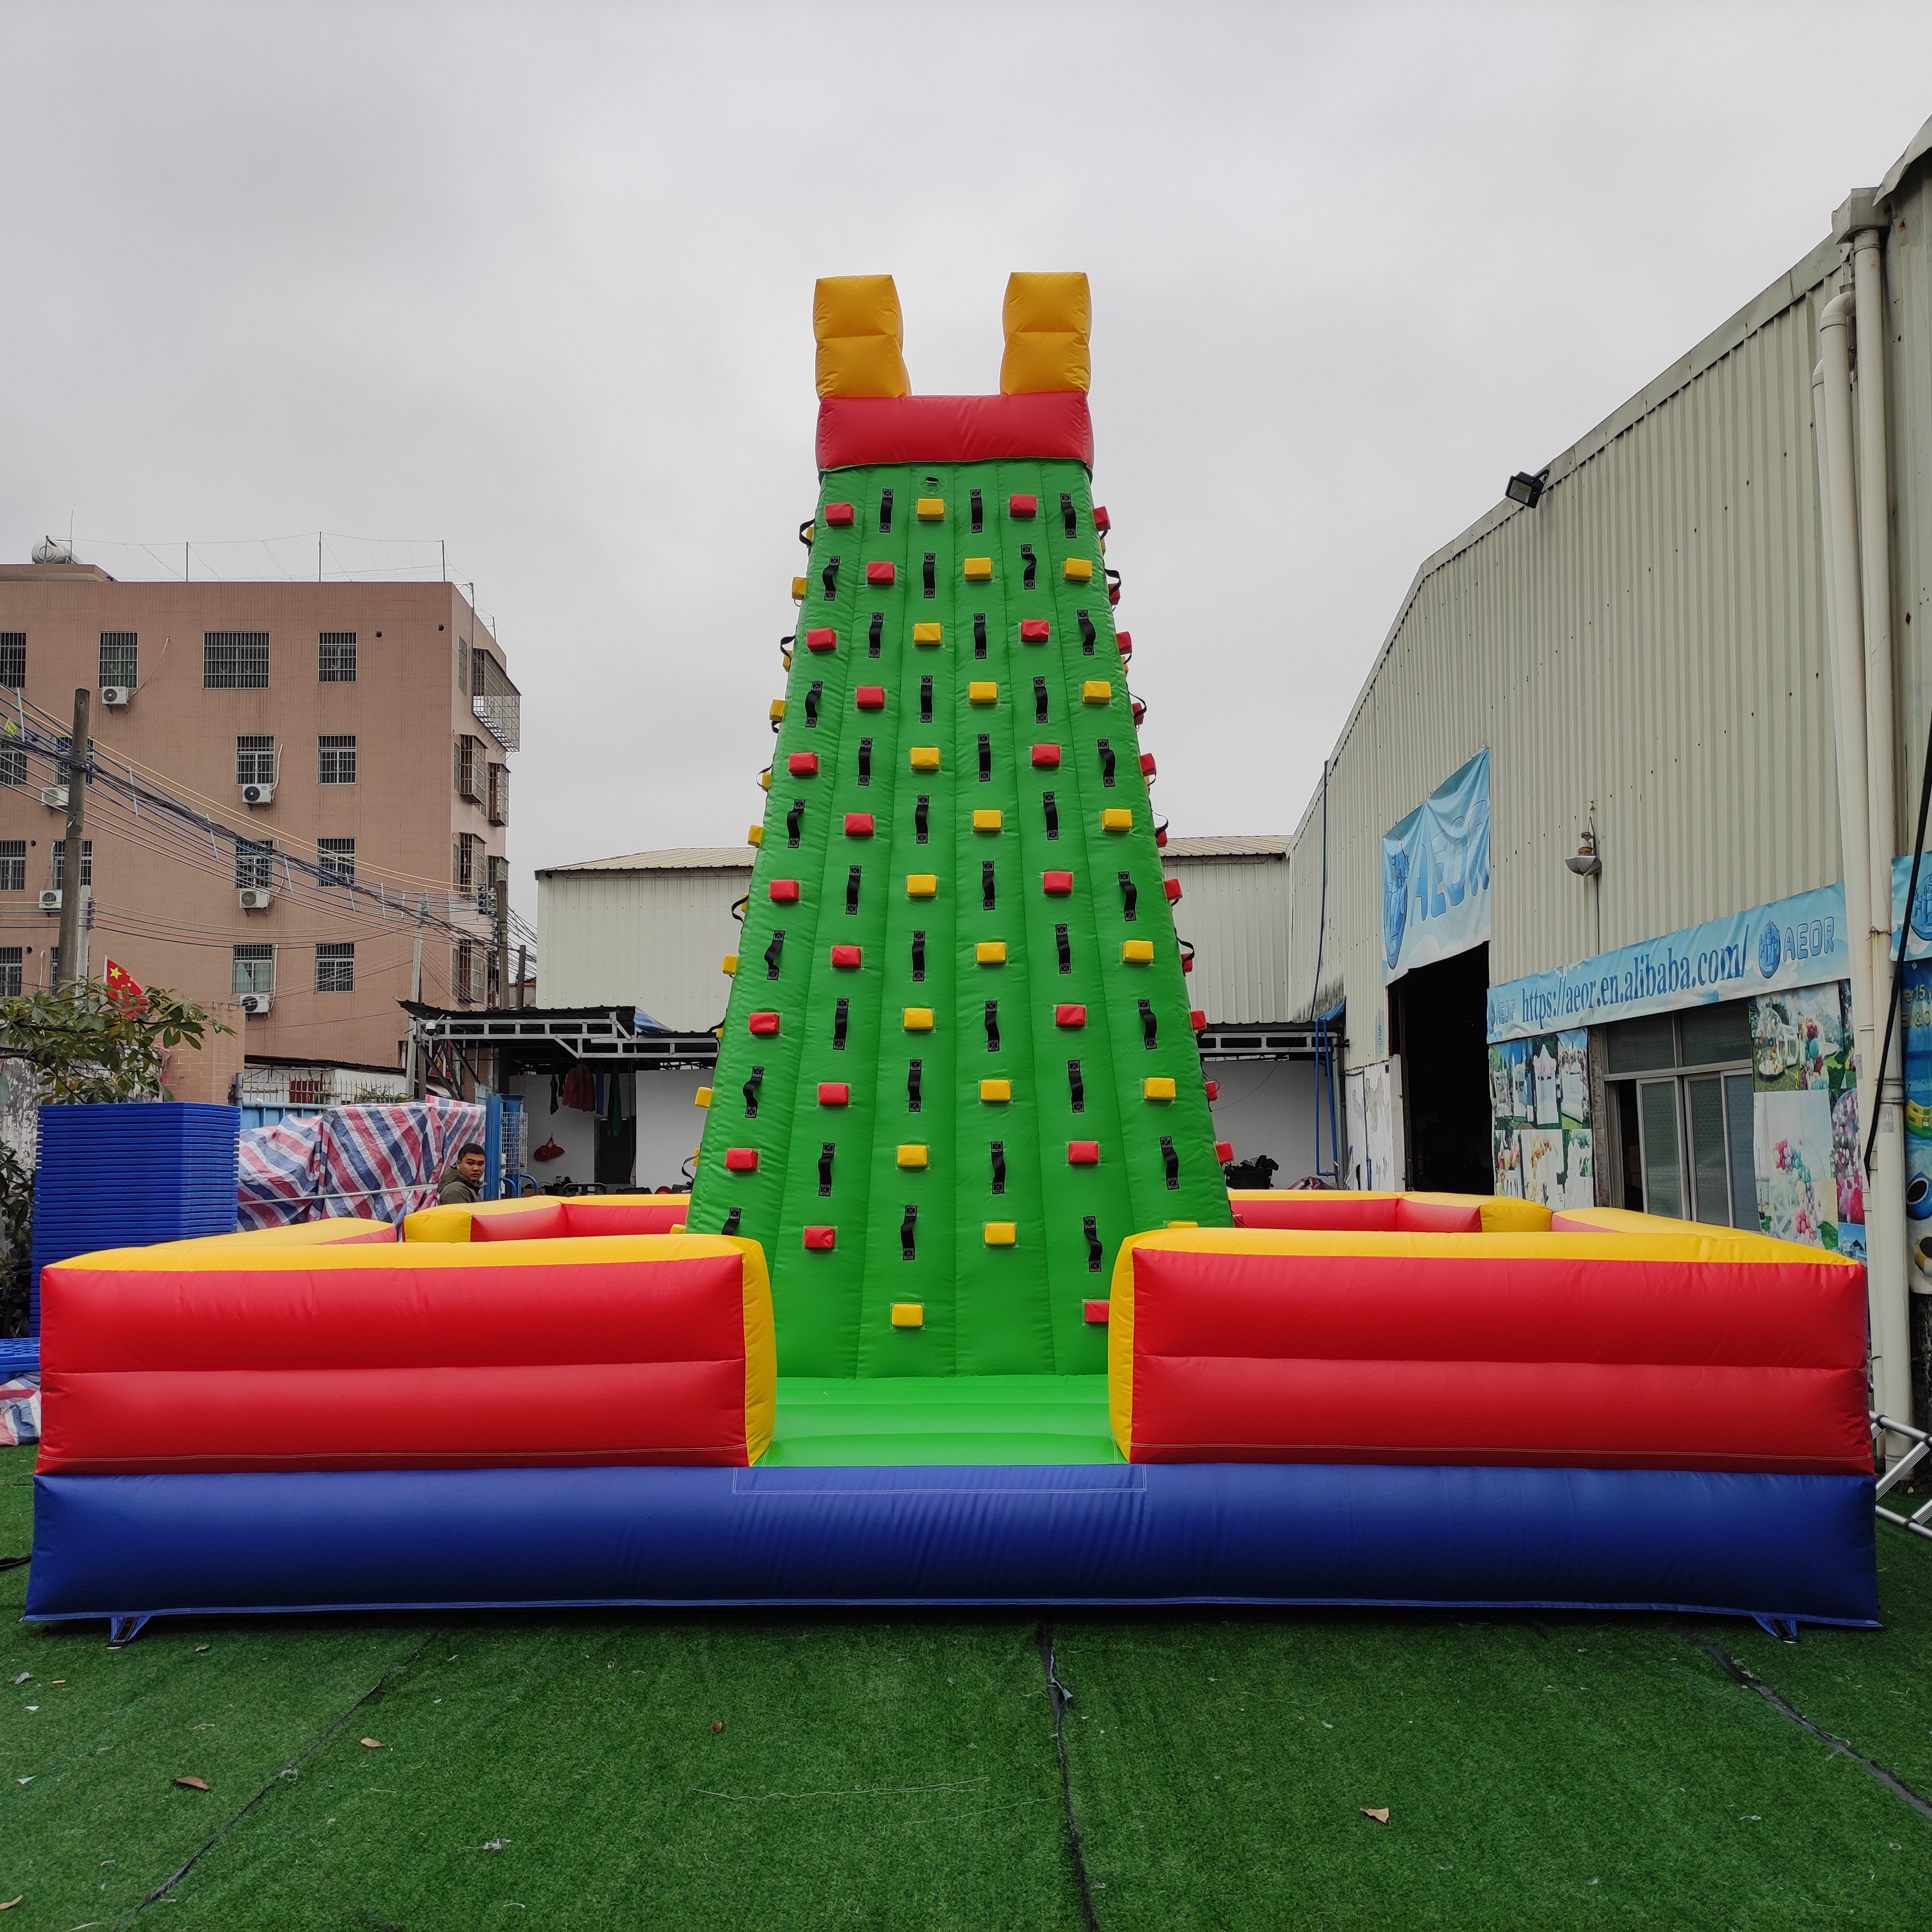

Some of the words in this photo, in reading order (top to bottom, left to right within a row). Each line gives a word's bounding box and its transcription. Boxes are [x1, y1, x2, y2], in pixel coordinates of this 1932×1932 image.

[1409, 800, 1490, 928] AEOR
[1783, 916, 1835, 963] AEOR
[1521, 924, 1749, 1029] https://aeor.en.alibaba.com/
[1915, 984, 1925, 1001] 15
[1496, 999, 1515, 1026] AEOR
